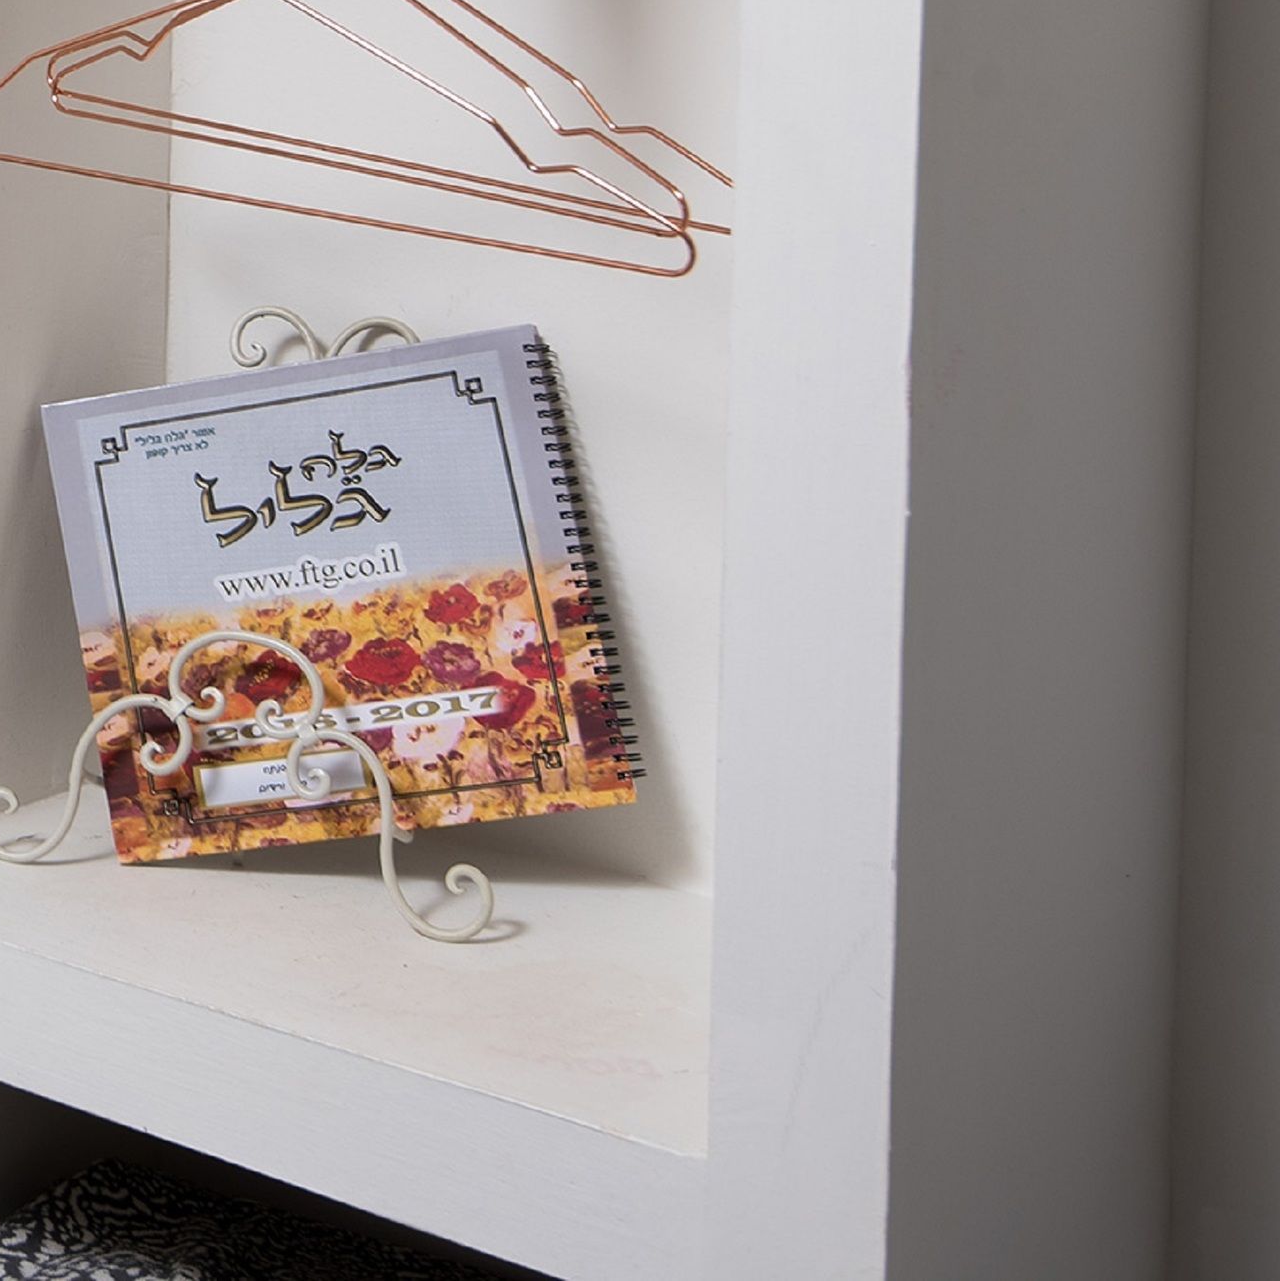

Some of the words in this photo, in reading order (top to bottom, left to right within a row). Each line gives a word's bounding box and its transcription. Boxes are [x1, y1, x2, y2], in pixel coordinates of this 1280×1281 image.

[171, 443, 193, 455] צריך
[195, 439, 209, 450] לא
[219, 548, 401, 597] www.ftg.co.il
[370, 689, 499, 723] 2017
